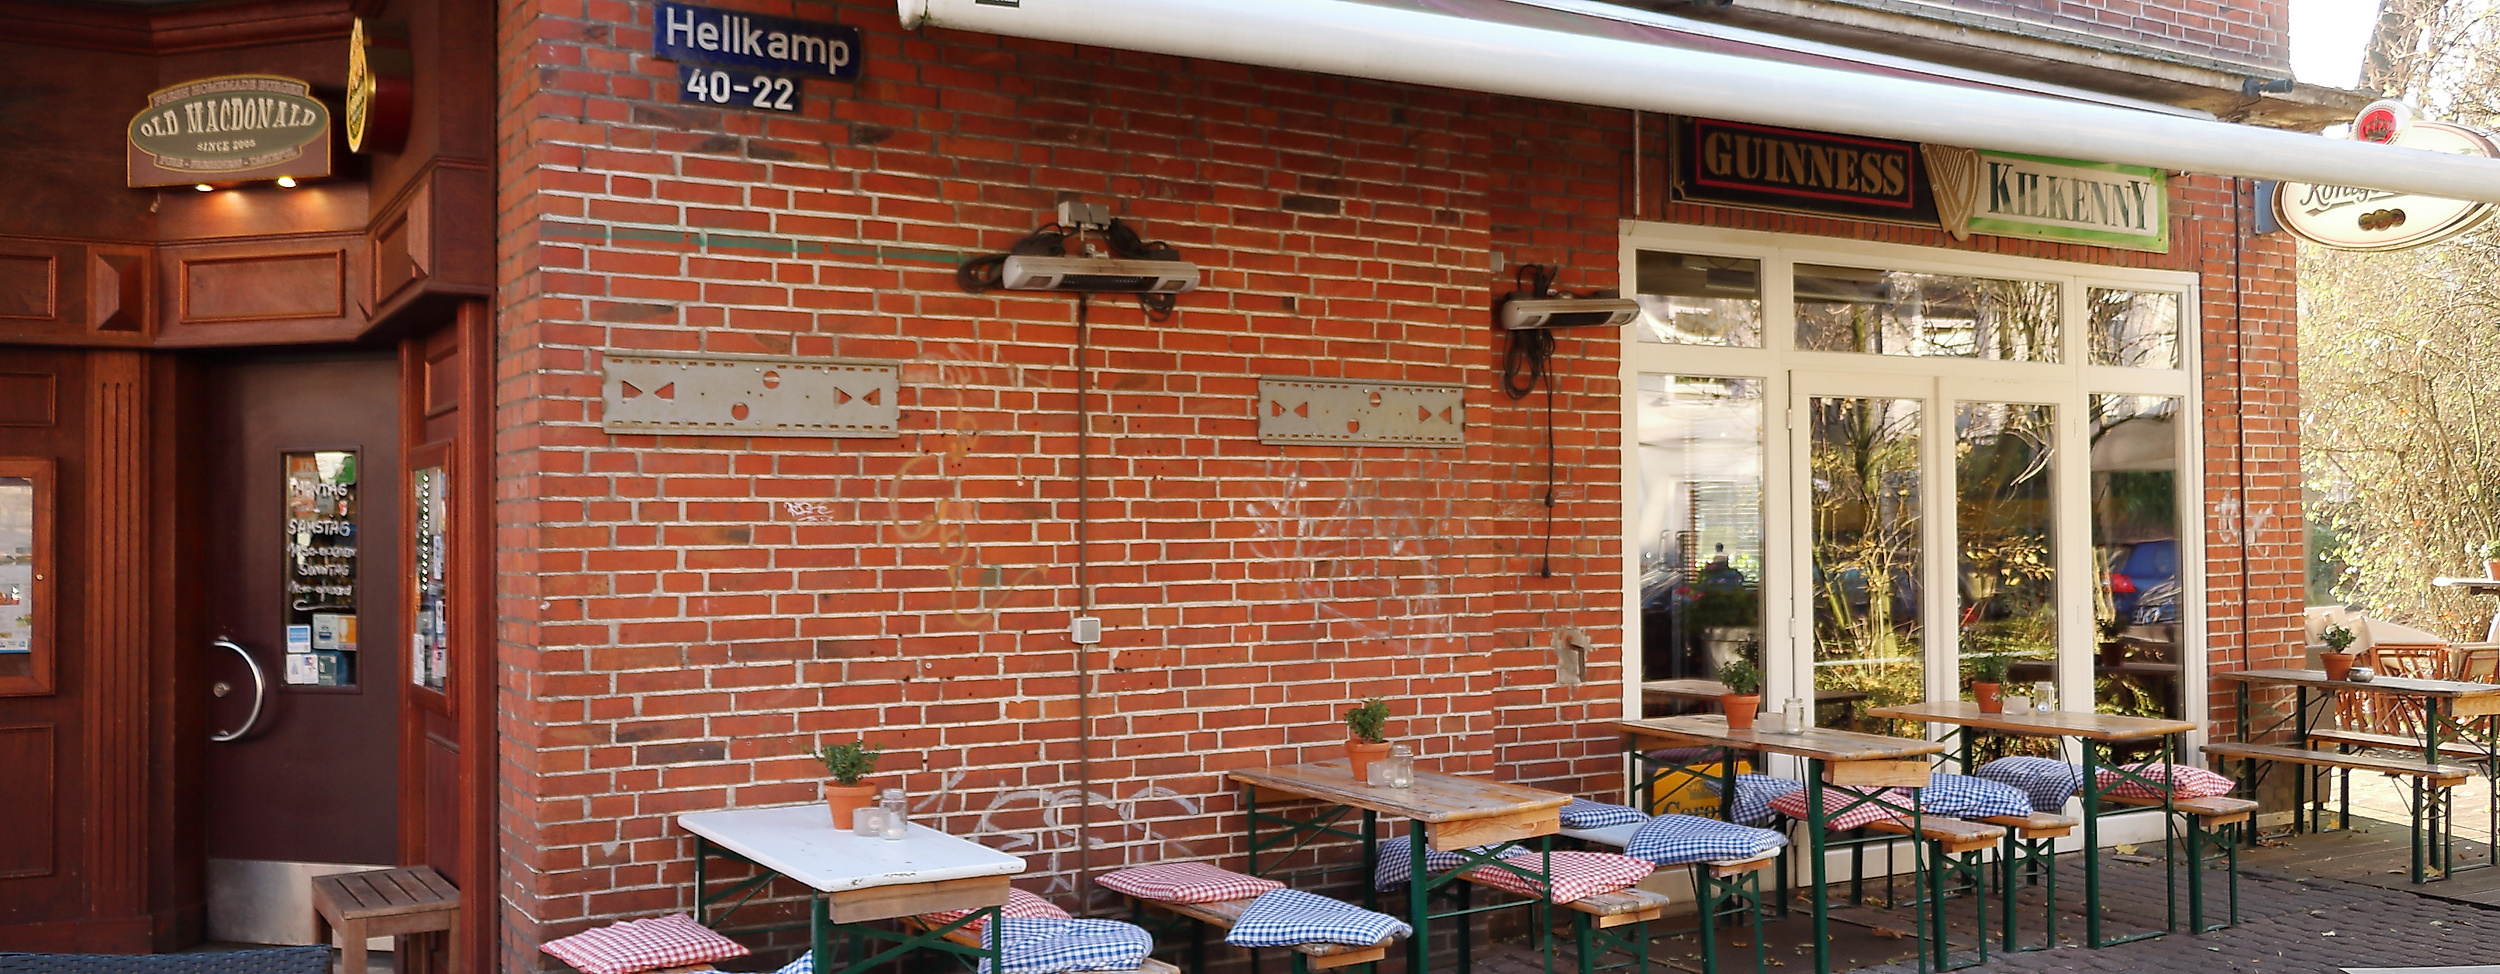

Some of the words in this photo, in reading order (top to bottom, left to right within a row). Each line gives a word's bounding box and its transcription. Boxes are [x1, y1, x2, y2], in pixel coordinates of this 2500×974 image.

[666, 6, 850, 76] Hellkamp
[686, 68, 795, 112] 40-22
[140, 109, 180, 137] OLD
[184, 97, 317, 134] MACDONALD
[196, 140, 231, 153] SINCE
[1704, 130, 1905, 197] GUINNESS
[1986, 161, 2151, 231] KILKENNY
[287, 518, 351, 537] SAMSTAG
